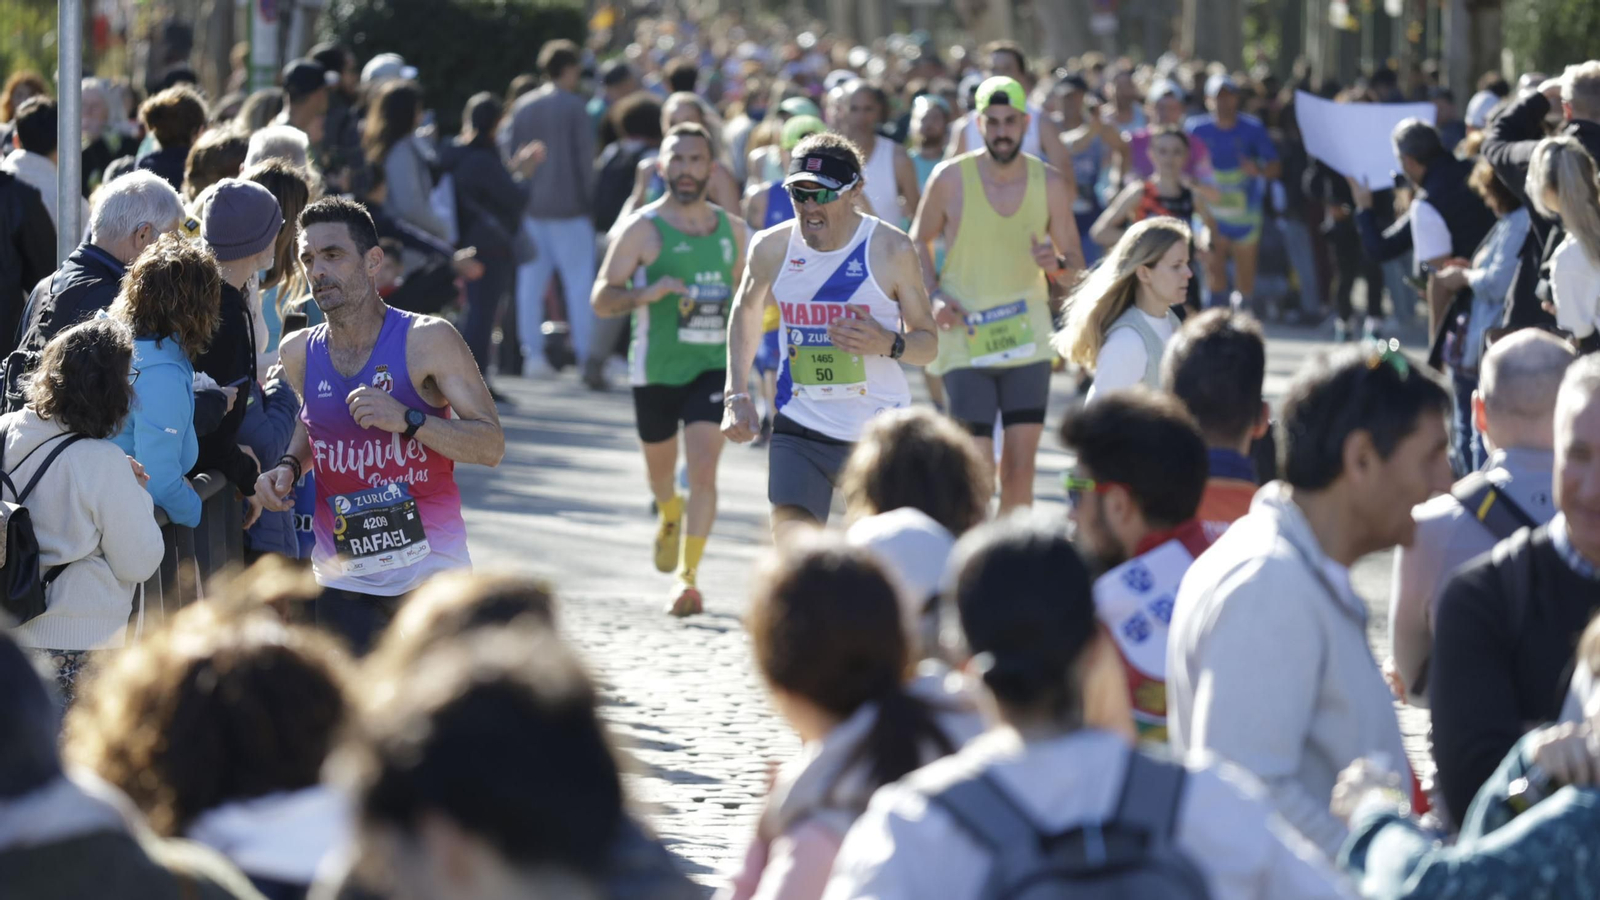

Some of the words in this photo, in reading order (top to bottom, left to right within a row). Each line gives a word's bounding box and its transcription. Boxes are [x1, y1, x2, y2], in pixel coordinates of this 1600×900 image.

[808, 333, 831, 343] ZUR
[811, 354, 834, 363] 1465
[816, 368, 833, 381] 50
[354, 487, 402, 506] ZURICH
[363, 516, 388, 530] 4209
[349, 528, 411, 555] RAFAEL
